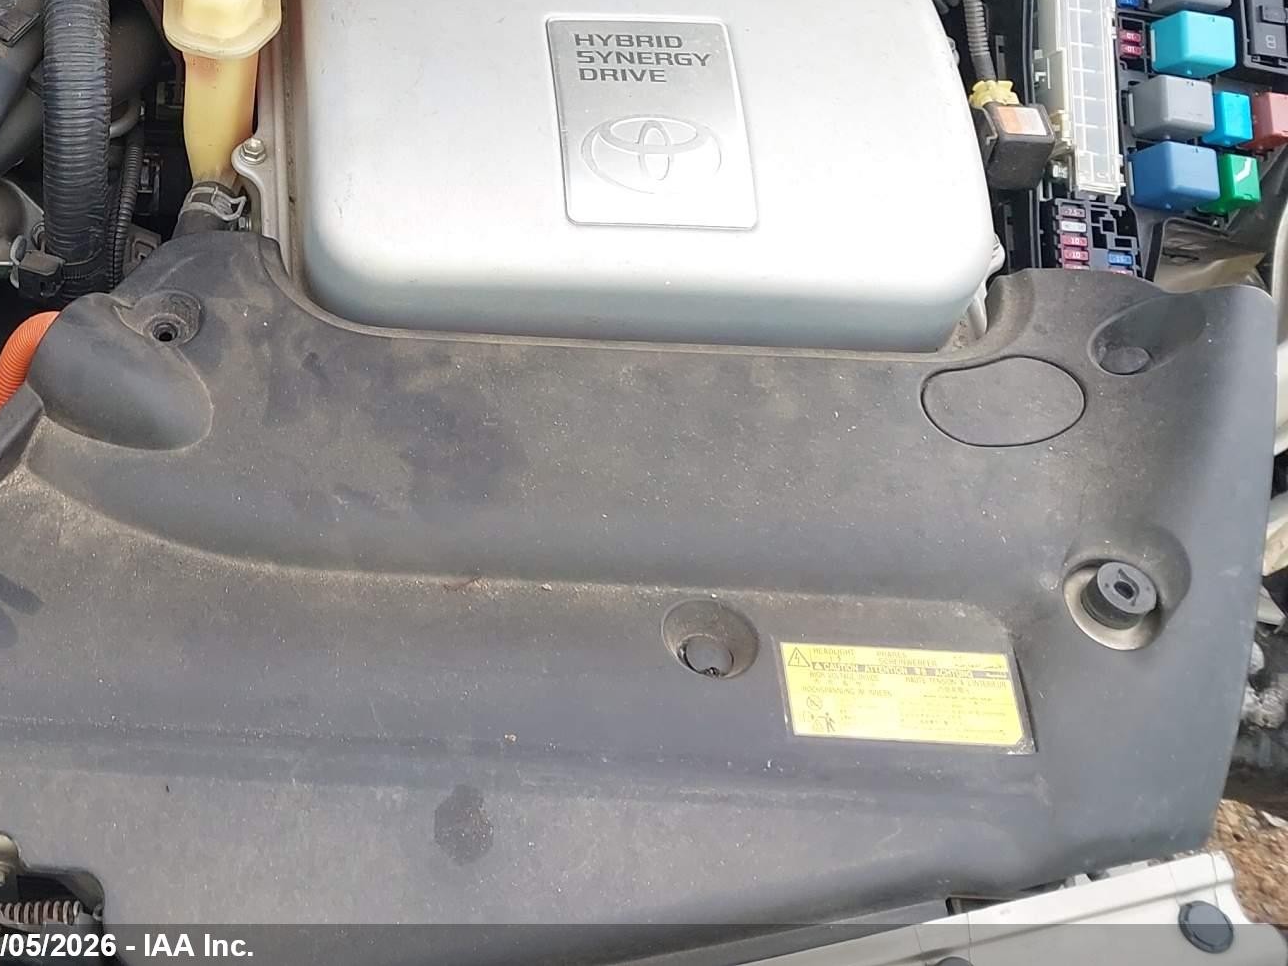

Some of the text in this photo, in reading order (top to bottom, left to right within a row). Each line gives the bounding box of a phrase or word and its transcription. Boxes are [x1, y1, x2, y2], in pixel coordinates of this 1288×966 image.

[574, 33, 683, 48] HYBRID
[576, 50, 712, 67] SYNERGY
[579, 67, 667, 83] DRIVE
[823, 663, 857, 672] CAUTION
[864, 665, 907, 675] ATTENTION
